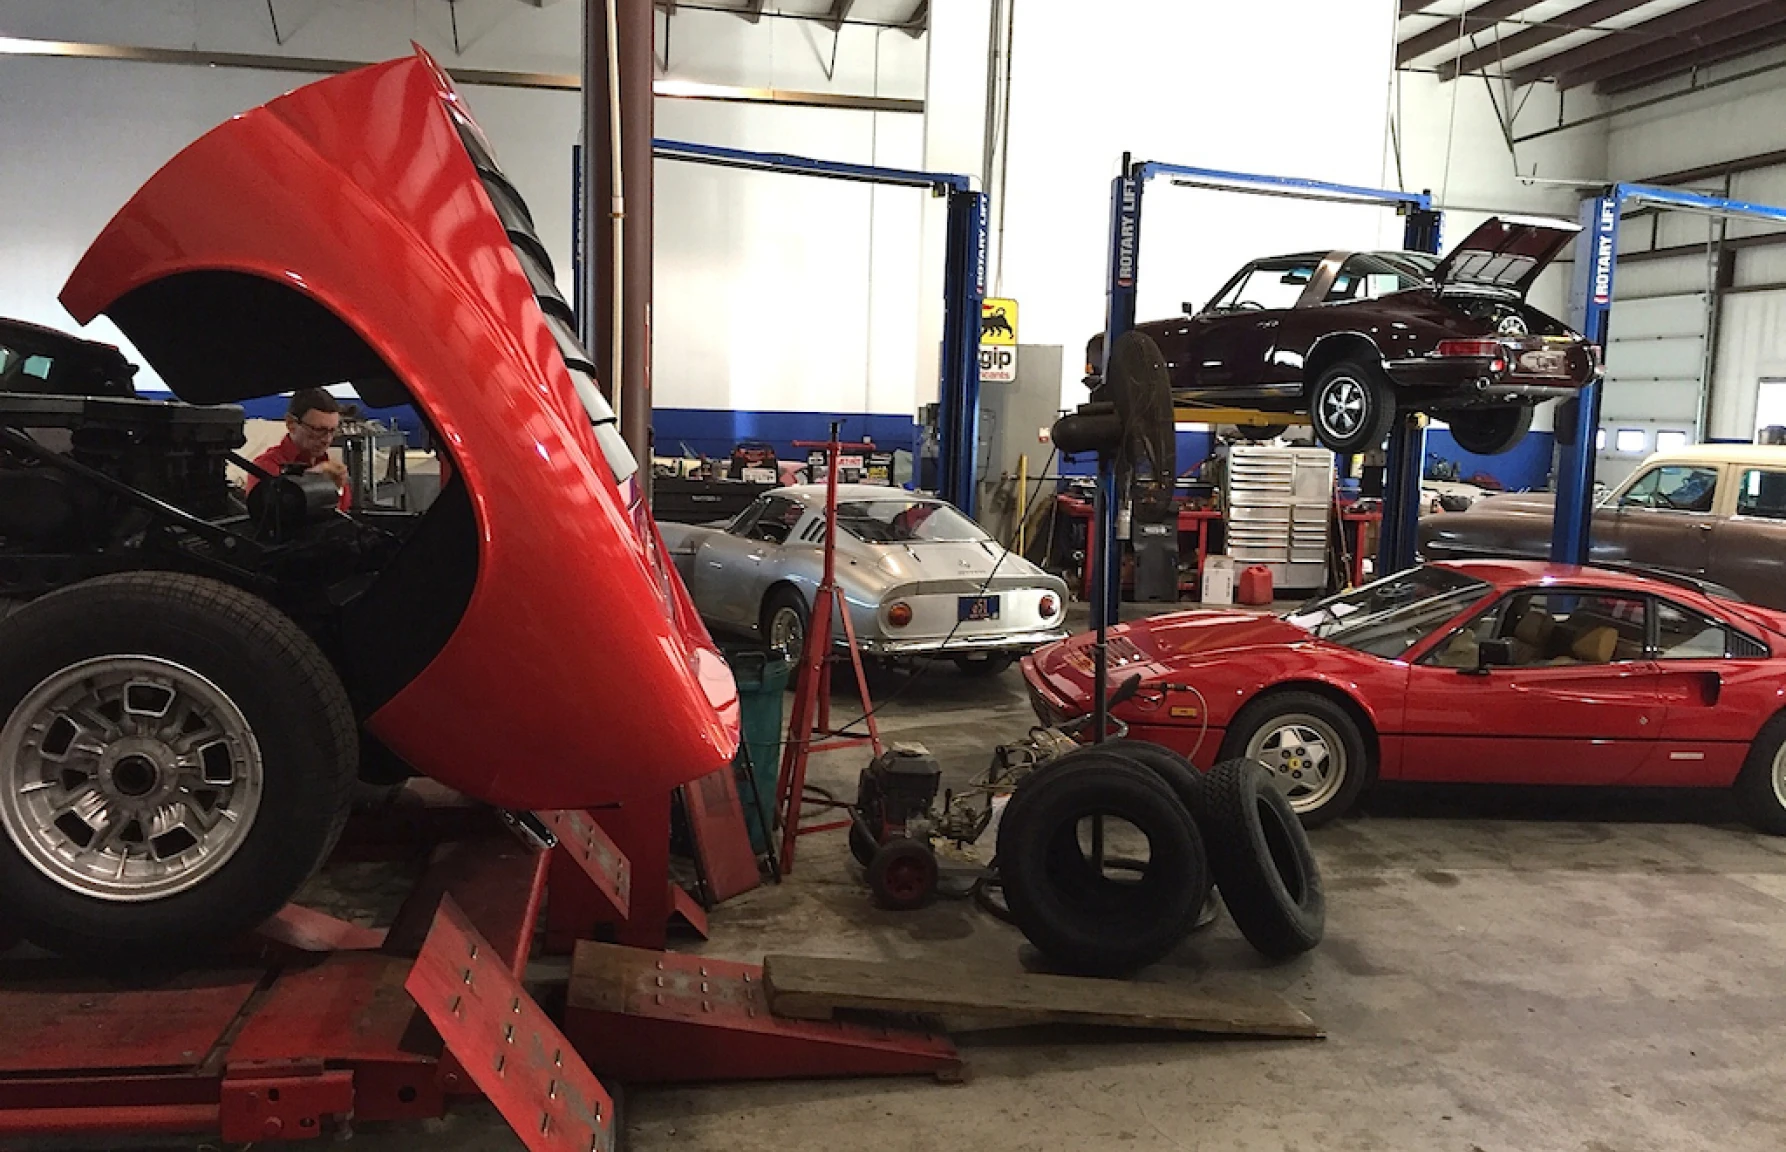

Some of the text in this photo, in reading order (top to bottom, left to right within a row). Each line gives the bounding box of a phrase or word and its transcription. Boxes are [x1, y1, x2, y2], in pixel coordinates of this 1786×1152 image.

[977, 228, 987, 286] ROTARY
[1119, 179, 1136, 278] ROTARY LIFT
[1596, 199, 1616, 295] ROTARY LIFT
[980, 346, 1012, 369] gip
